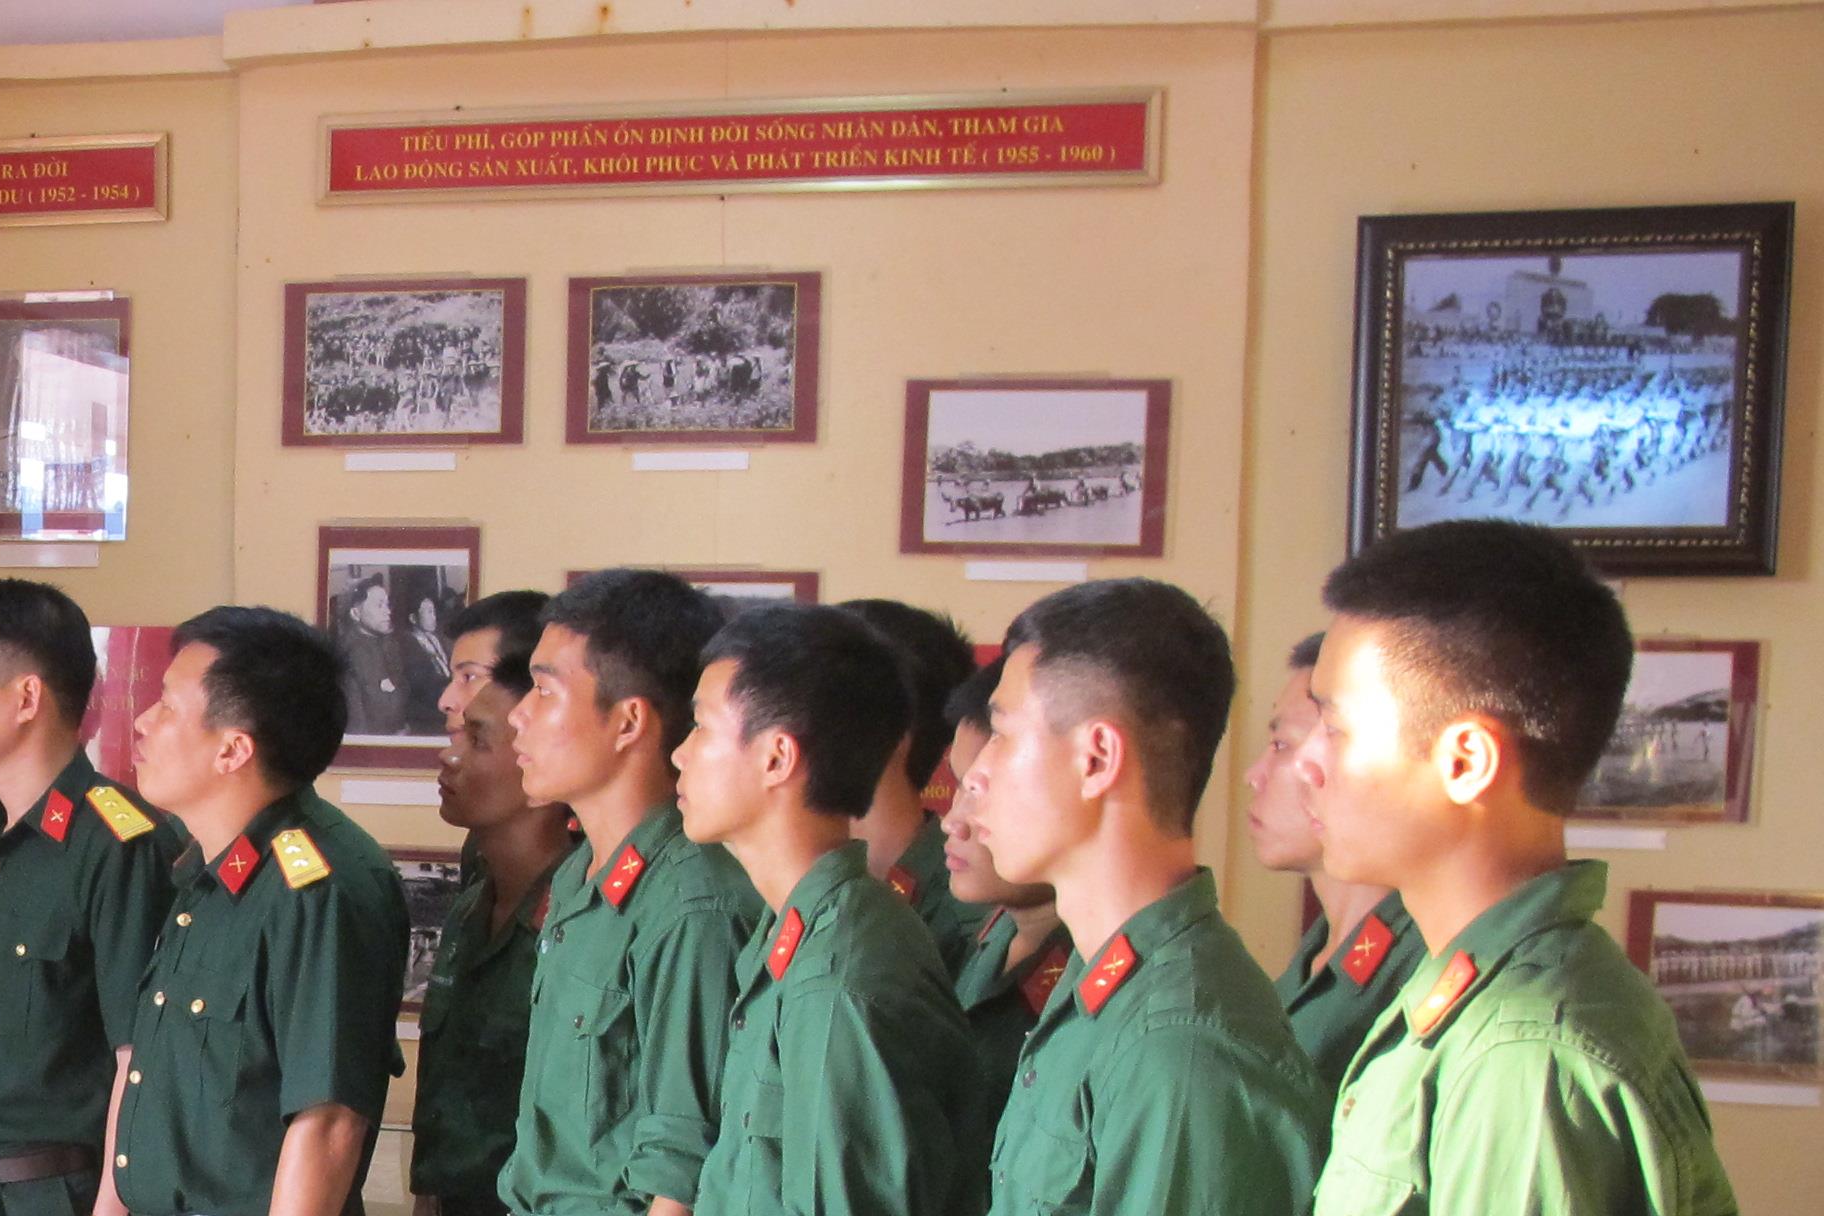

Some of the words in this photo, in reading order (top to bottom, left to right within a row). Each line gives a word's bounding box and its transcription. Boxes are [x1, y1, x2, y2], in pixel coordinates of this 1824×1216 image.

[500, 127, 545, 149] GÓP
[550, 122, 608, 147] PHẦN
[650, 126, 705, 148] ĐỊNH
[710, 120, 749, 142] ĐỜI
[755, 116, 816, 142] SỐNG
[821, 117, 885, 140] NHÂN
[949, 116, 1018, 137] THAM
[1023, 115, 1064, 133] GIA
[1, 164, 28, 180] RA
[32, 156, 69, 178] ĐỜI
[354, 164, 398, 181] LAO
[404, 158, 463, 182] ĐỘNG
[469, 155, 509, 178] SẢN
[645, 154, 704, 176] PHỤC
[711, 149, 740, 171] VÀ
[745, 147, 805, 170] PHÁT
[810, 142, 876, 169] TRIỂN
[884, 148, 941, 167] KINH
[947, 140, 977, 165] TẾ
[997, 145, 1040, 164] 1955
[1059, 144, 1104, 163] 1960
[40, 186, 76, 203] 1952
[92, 184, 129, 201] 1954
